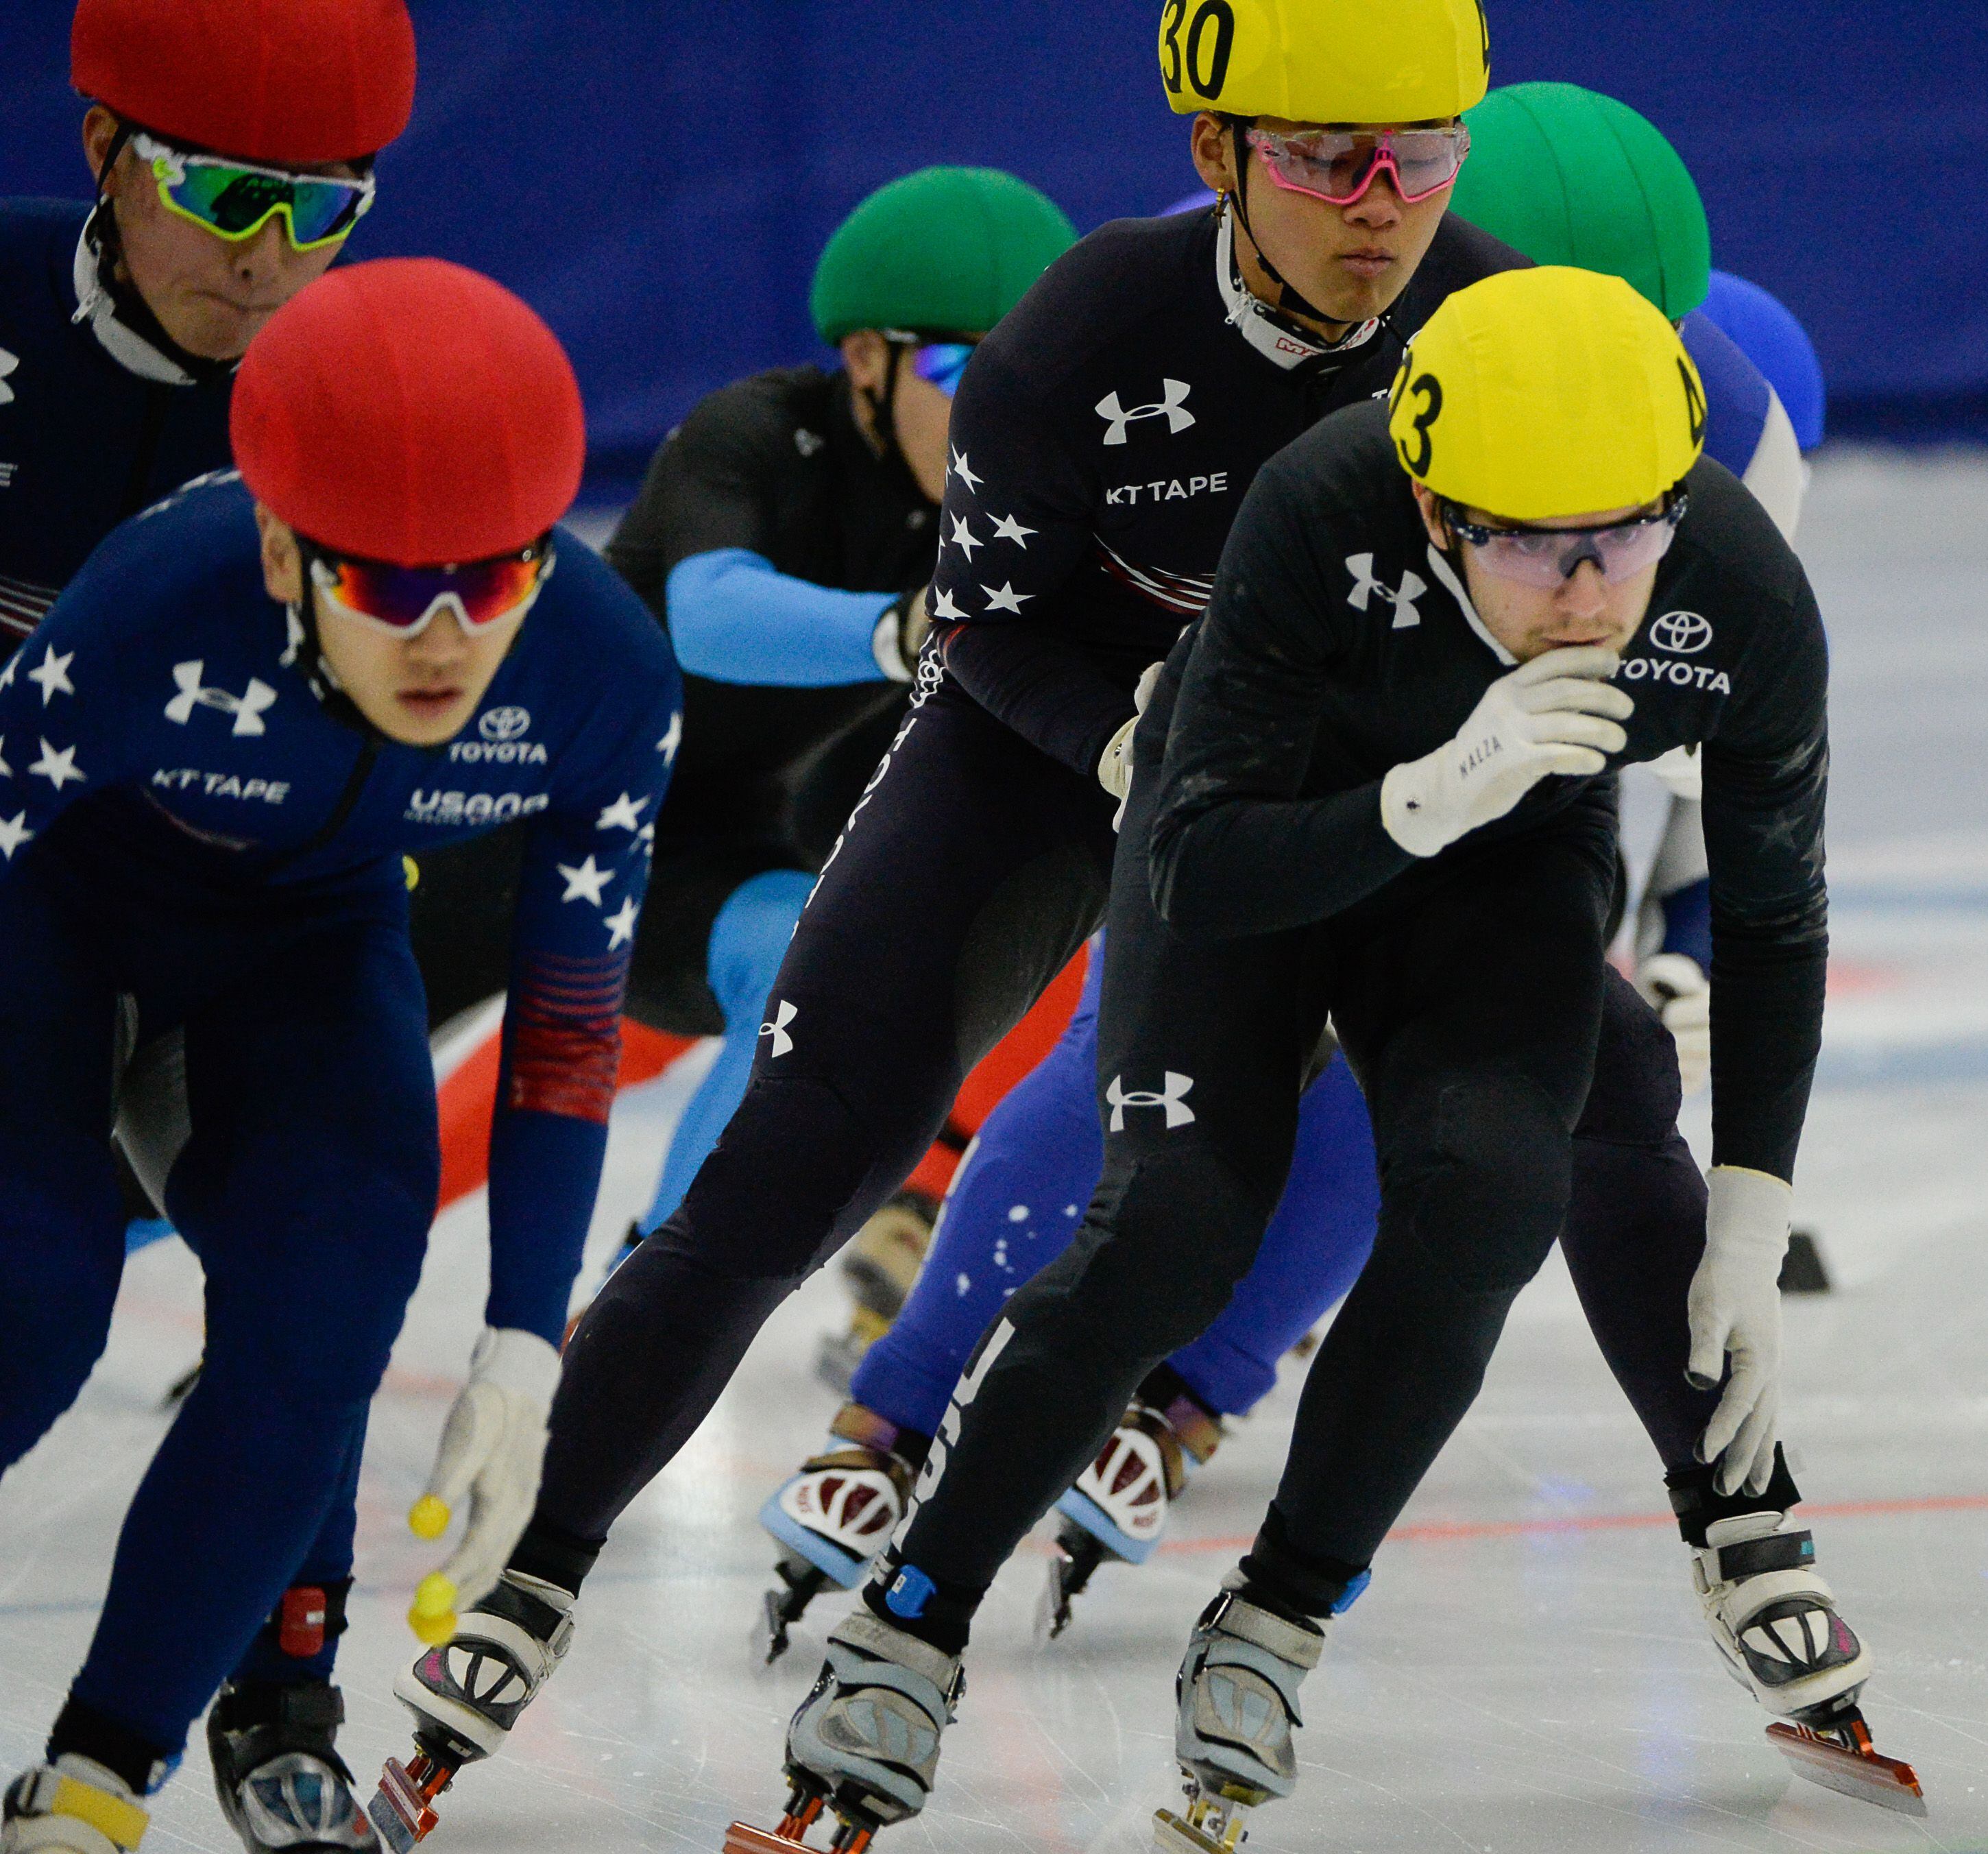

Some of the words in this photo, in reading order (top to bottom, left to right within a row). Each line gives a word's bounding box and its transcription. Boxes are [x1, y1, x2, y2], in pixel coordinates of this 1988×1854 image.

[1106, 485, 1143, 505] KT
[1148, 472, 1228, 502] TAPE
[448, 741, 548, 766] TOYOTA
[151, 768, 201, 789] KT
[204, 772, 291, 805] TAPE
